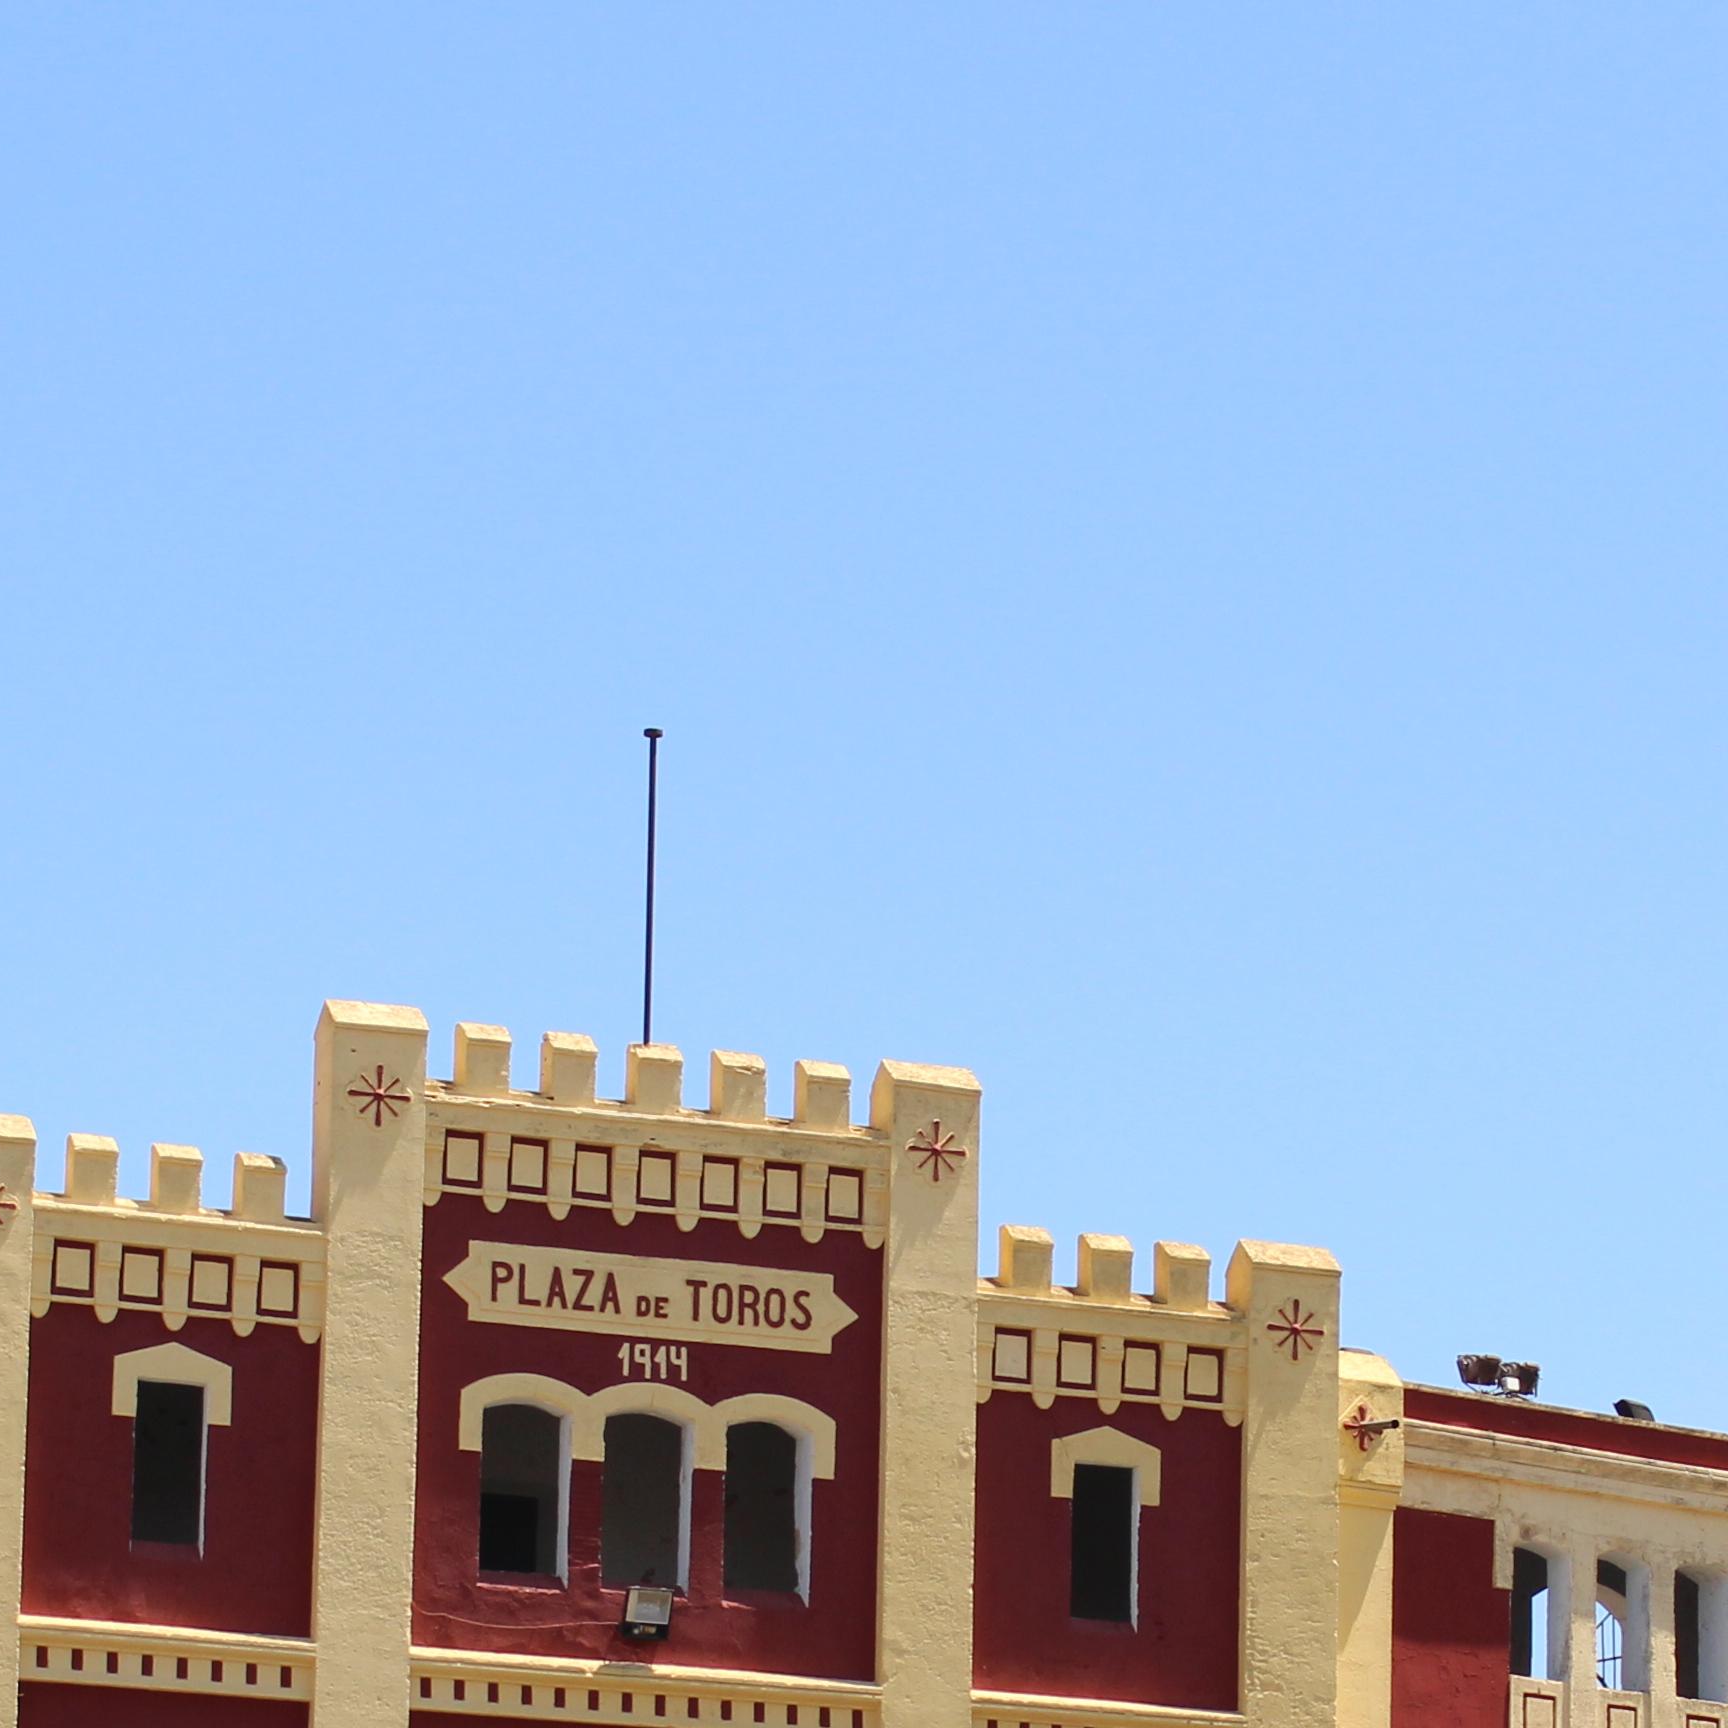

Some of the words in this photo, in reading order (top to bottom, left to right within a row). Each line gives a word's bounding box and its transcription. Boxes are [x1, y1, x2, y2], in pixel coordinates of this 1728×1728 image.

[490, 1261, 621, 1315] PLAZA
[635, 1295, 669, 1319] DE
[685, 1280, 813, 1331] TOROS
[618, 1343, 689, 1382] 1914
